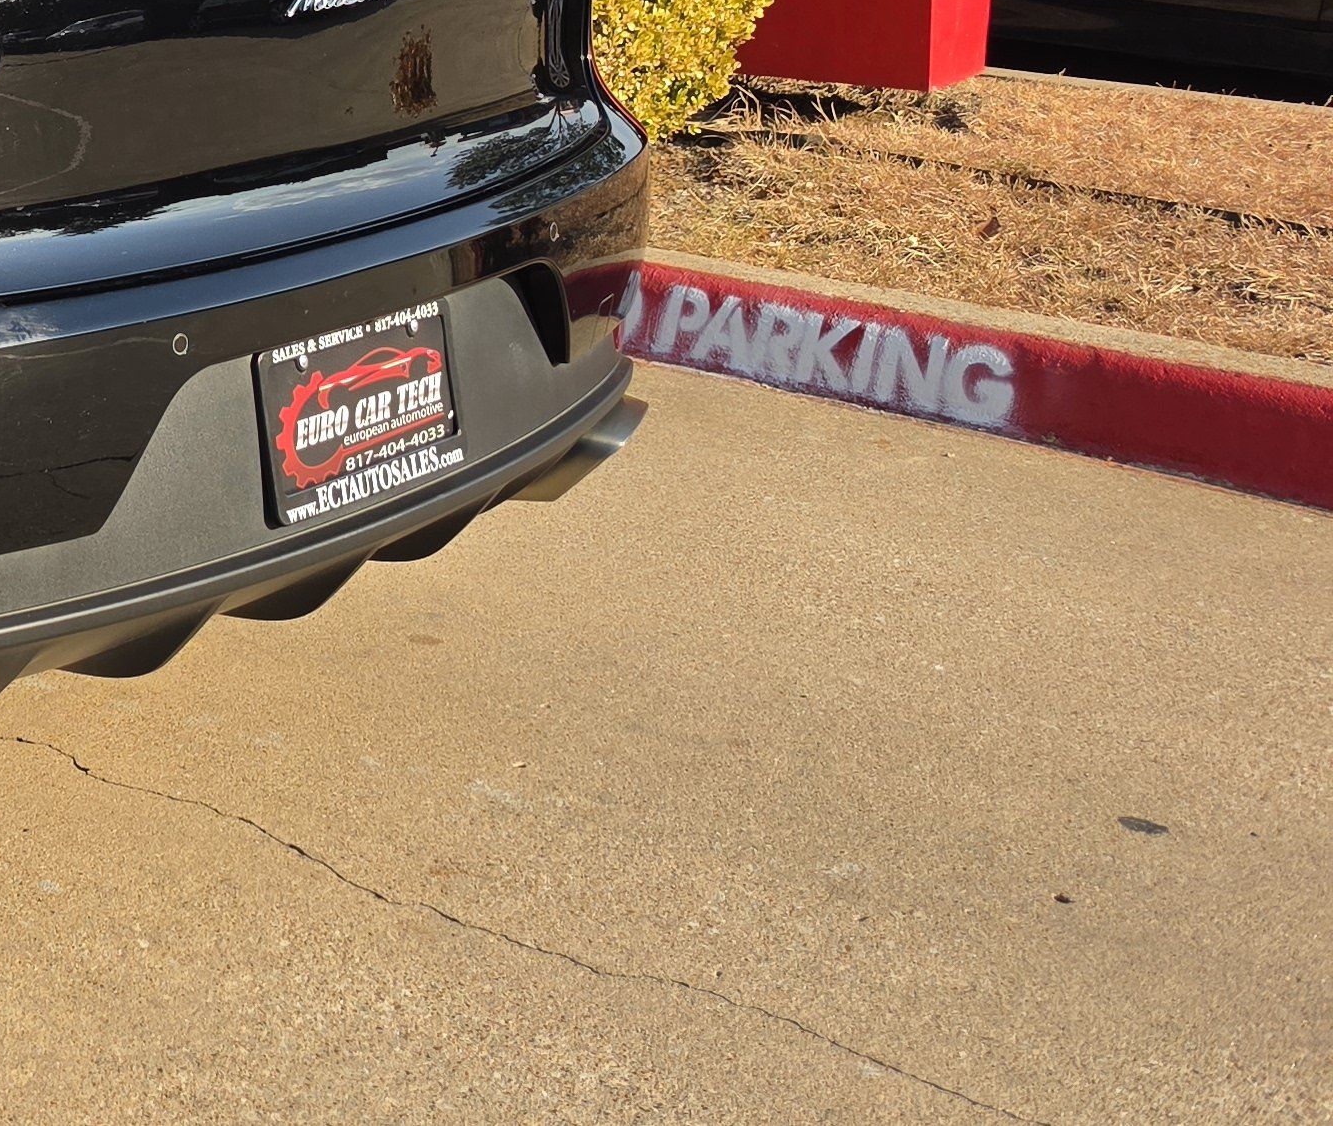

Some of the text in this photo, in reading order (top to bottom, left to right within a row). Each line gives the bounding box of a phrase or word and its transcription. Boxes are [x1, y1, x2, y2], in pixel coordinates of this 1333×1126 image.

[272, 301, 439, 364] SALES & SERVICE 817-404-4033
[650, 283, 1017, 431] PARKING
[296, 372, 442, 450] EURO CAR TECH
[343, 401, 444, 446] european automotive
[345, 424, 445, 471] 817-404-4033
[286, 446, 465, 524] www.ECTAUTOSALES.com
